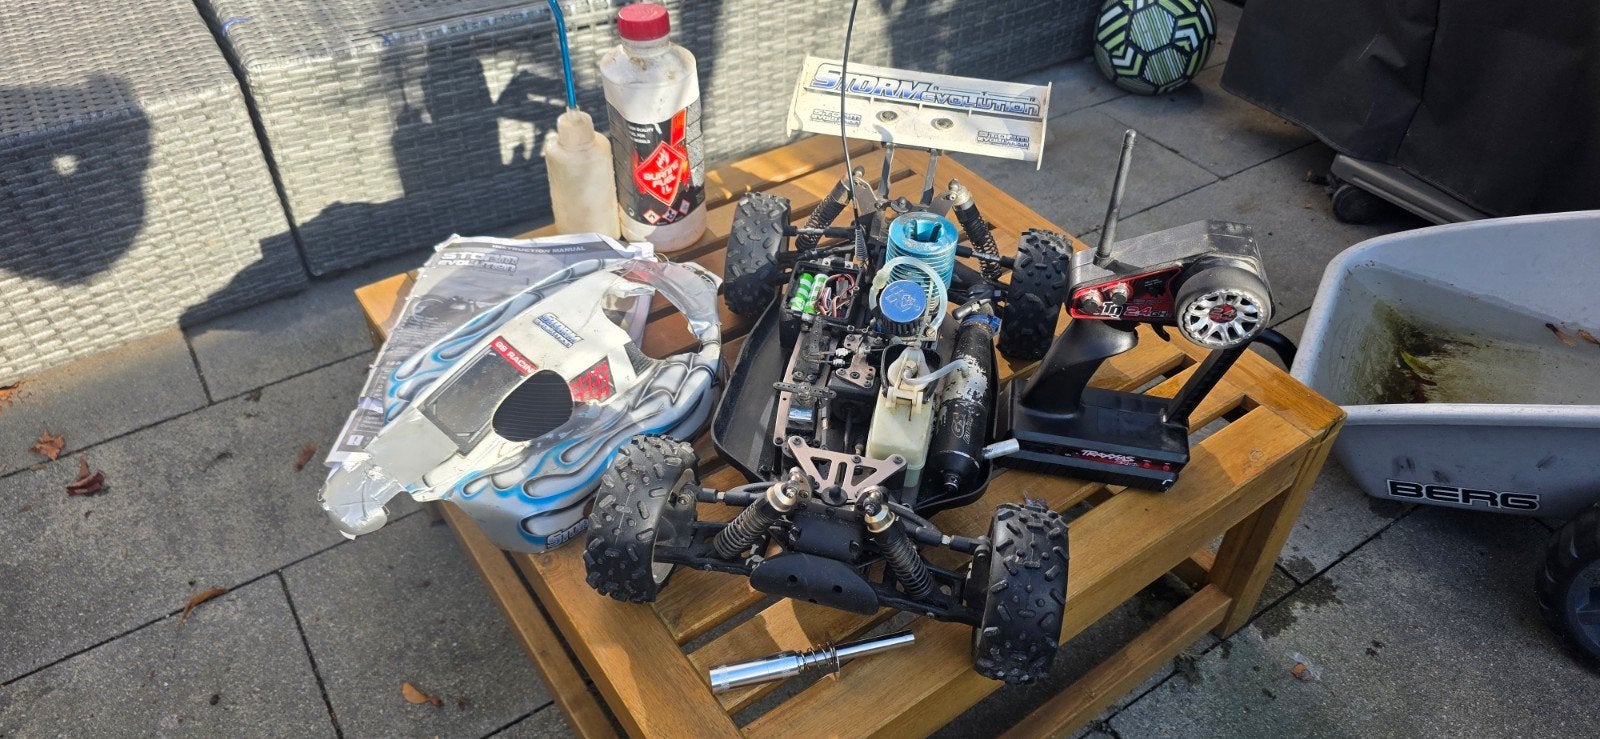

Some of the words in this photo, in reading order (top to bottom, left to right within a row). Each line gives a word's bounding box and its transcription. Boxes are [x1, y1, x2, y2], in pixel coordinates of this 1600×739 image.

[810, 63, 933, 100] STORM
[919, 91, 1040, 116] EVOLUTION
[552, 246, 586, 254] MANUAL
[1081, 449, 1135, 462] TRAXXAS
[1387, 479, 1540, 510] BERG
